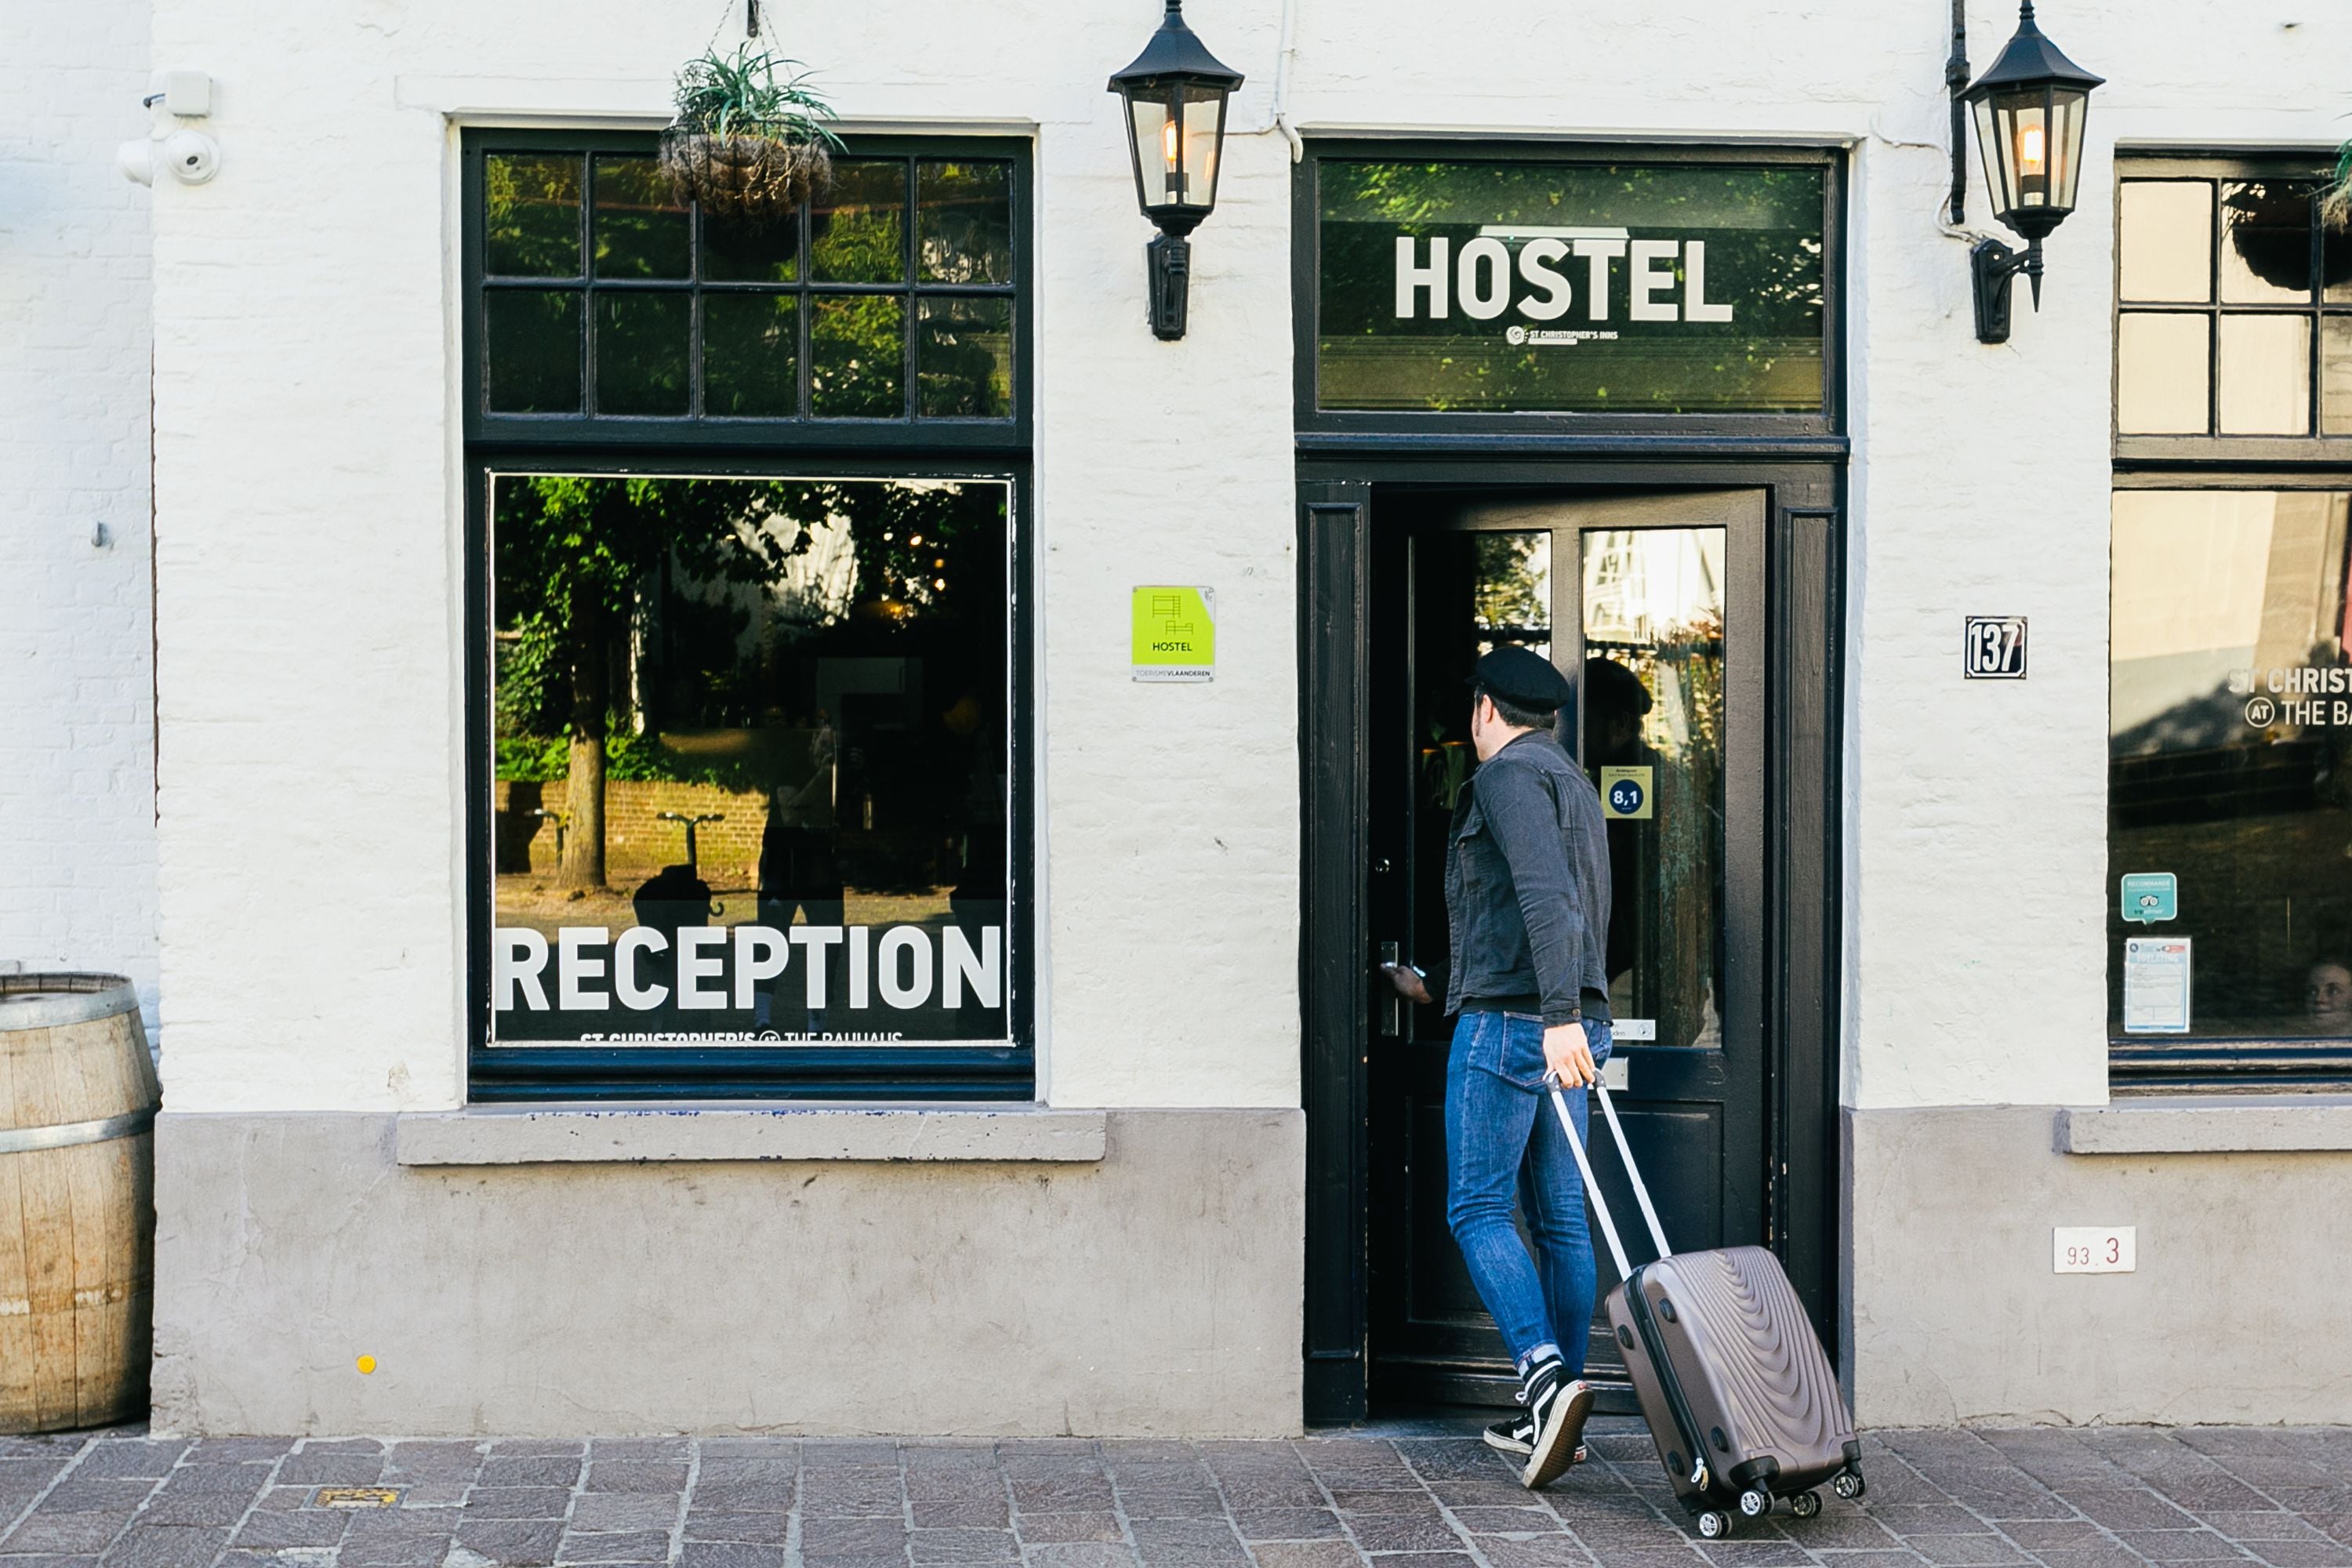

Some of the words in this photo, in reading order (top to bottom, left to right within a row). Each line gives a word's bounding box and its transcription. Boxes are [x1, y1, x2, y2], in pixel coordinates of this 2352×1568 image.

[1396, 237, 1733, 323] HOSTEL
[1152, 642, 1192, 652] HOSTEL
[1972, 624, 2020, 672] 137
[2227, 668, 2259, 693] ST
[2281, 701, 2326, 725] THE
[1613, 790, 1638, 806] 8,1
[495, 925, 1001, 1011] RECEPTION
